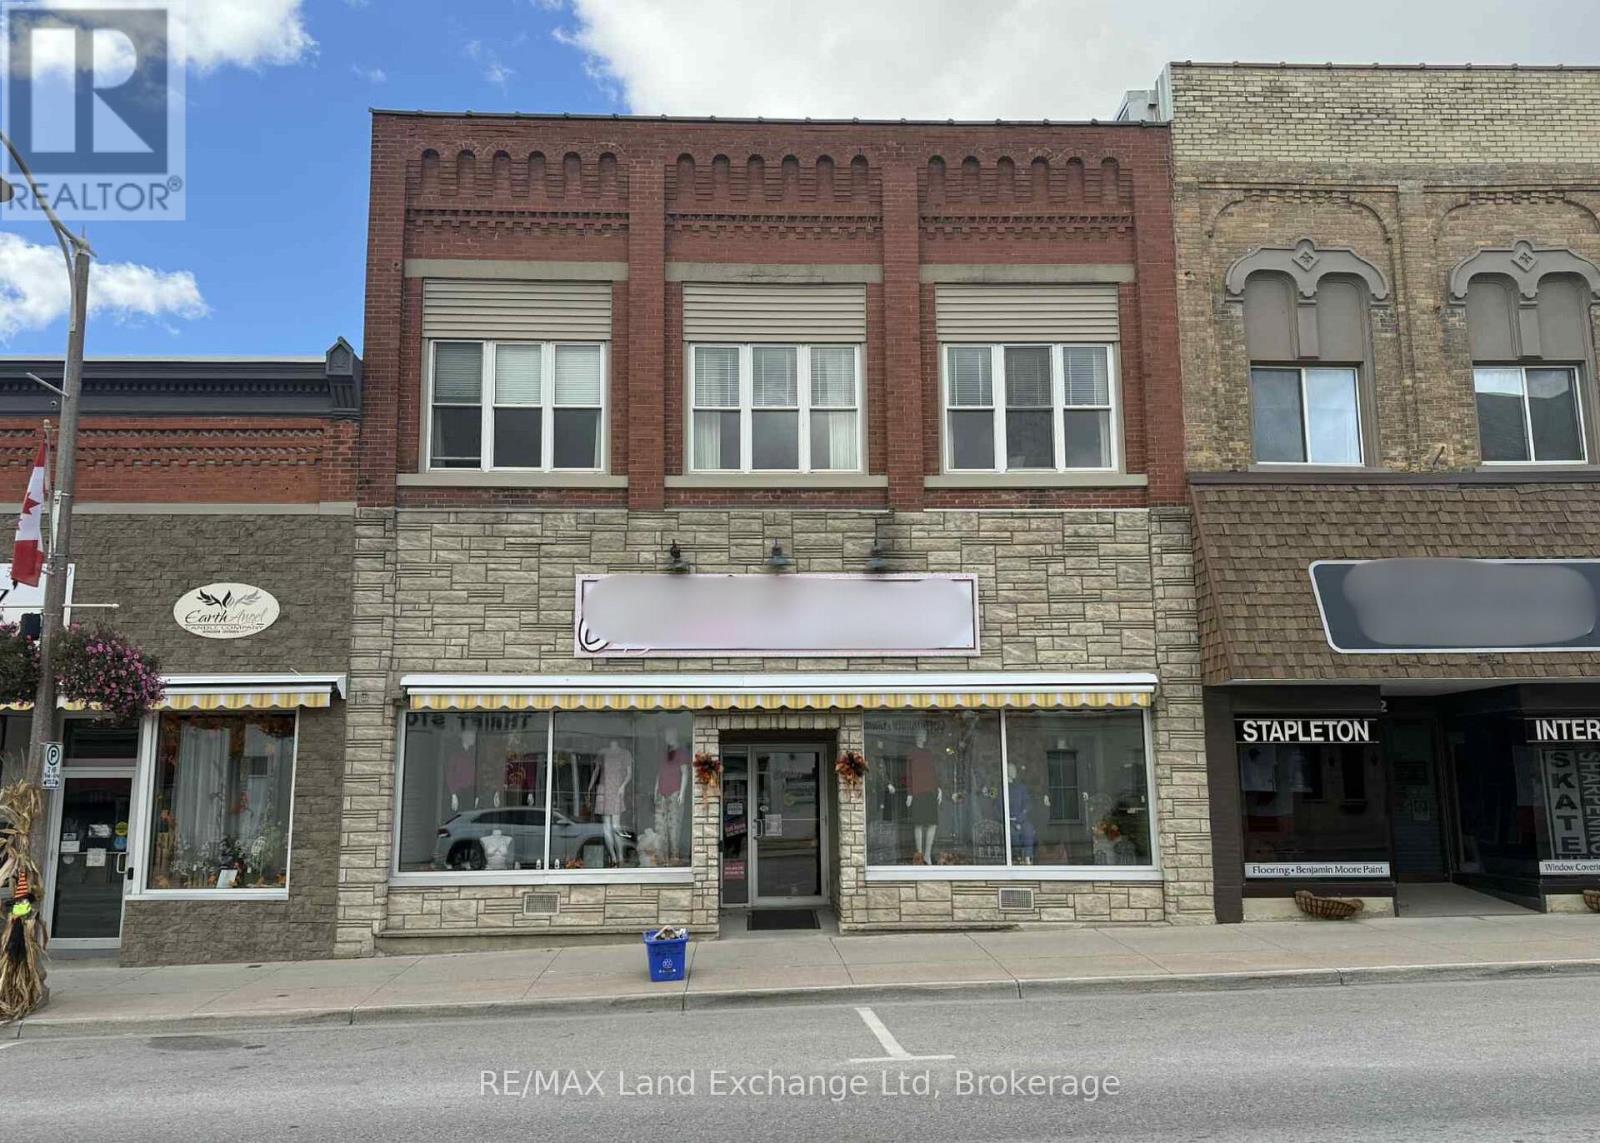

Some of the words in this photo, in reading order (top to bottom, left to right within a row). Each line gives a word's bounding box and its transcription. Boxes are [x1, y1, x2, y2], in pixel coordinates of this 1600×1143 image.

[185, 609, 227, 624] Earth
[1243, 720, 1370, 742] STAPLETON
[1551, 751, 1580, 853] SKATE
[1252, 866, 1290, 876] Flooring
[1296, 866, 1332, 874] Benjamin
[1363, 865, 1383, 873] Paint
[1545, 863, 1574, 871] Window
[1575, 863, 1600, 871] Coveri
